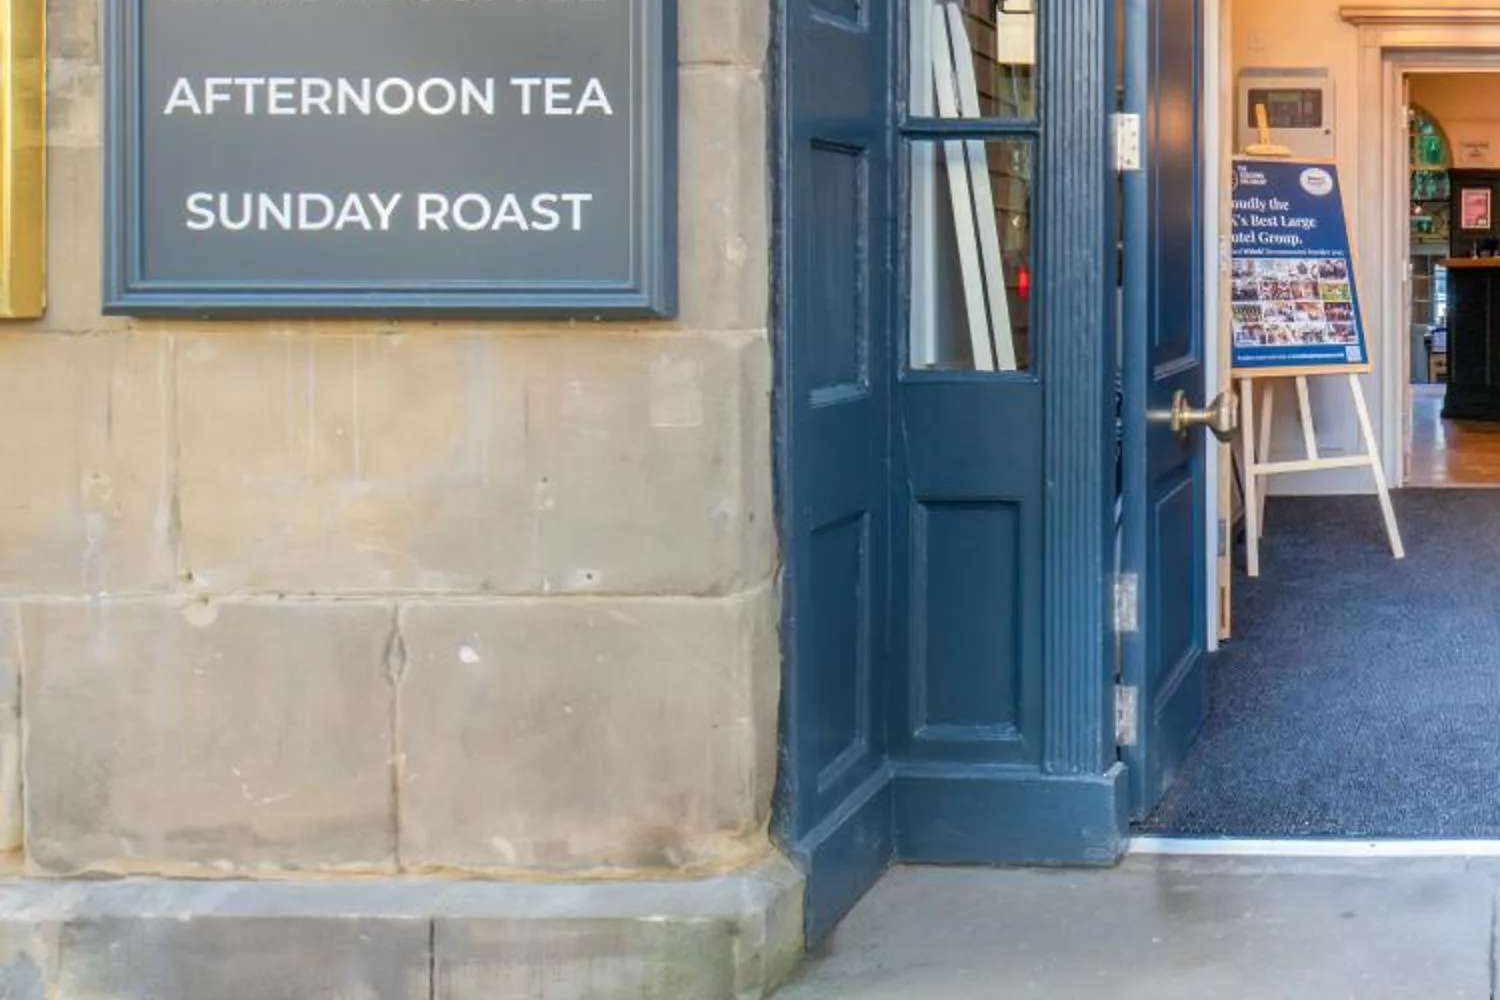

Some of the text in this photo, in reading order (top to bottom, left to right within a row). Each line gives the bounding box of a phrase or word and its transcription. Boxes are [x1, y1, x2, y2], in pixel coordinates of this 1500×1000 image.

[163, 77, 613, 115] AFTERNOON TEA
[186, 192, 593, 231] SUNDAY ROAST
[1231, 197, 1290, 213] oudly the
[1250, 215, 1278, 227] Best
[1280, 215, 1318, 230] Large
[1231, 230, 1256, 243] otel
